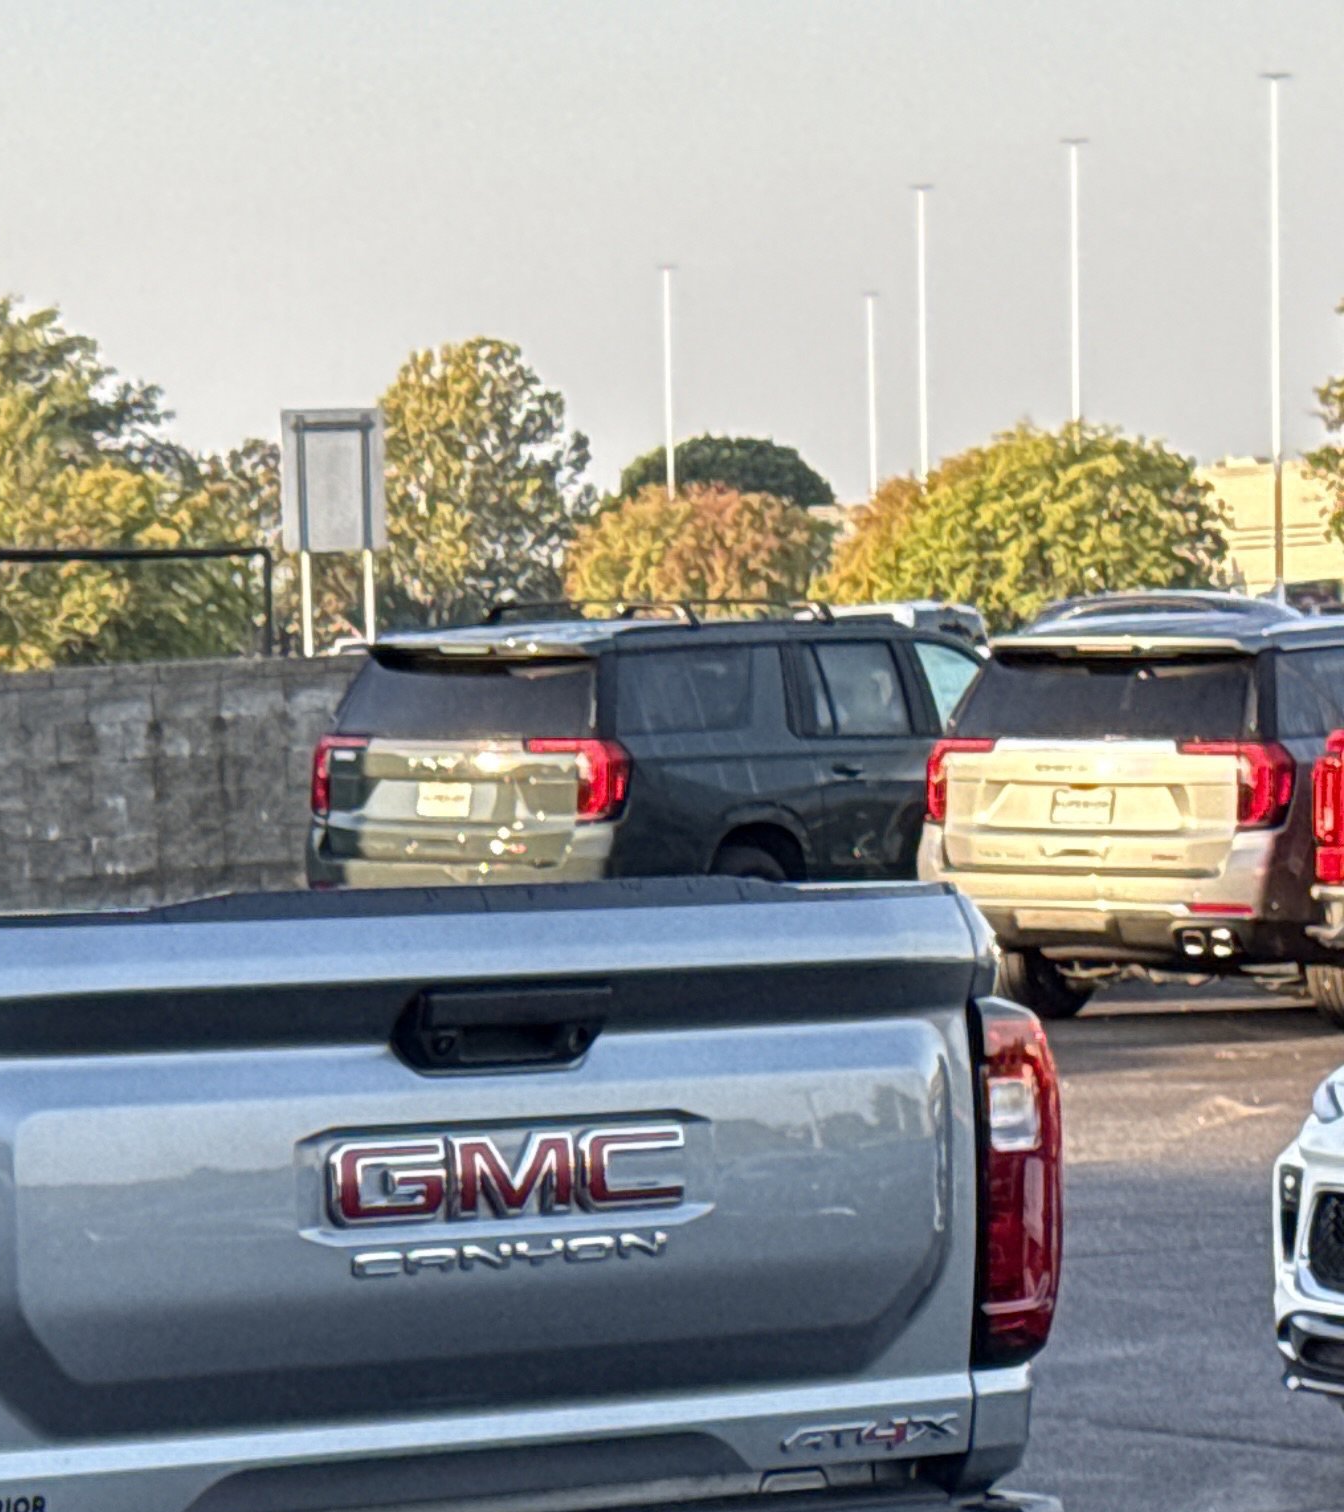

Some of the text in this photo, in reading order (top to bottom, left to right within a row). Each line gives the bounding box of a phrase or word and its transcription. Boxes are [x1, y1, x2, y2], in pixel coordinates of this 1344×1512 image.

[325, 1124, 686, 1229] GMC
[352, 1231, 668, 1277] CANYON
[780, 1412, 960, 1453] AT4X
